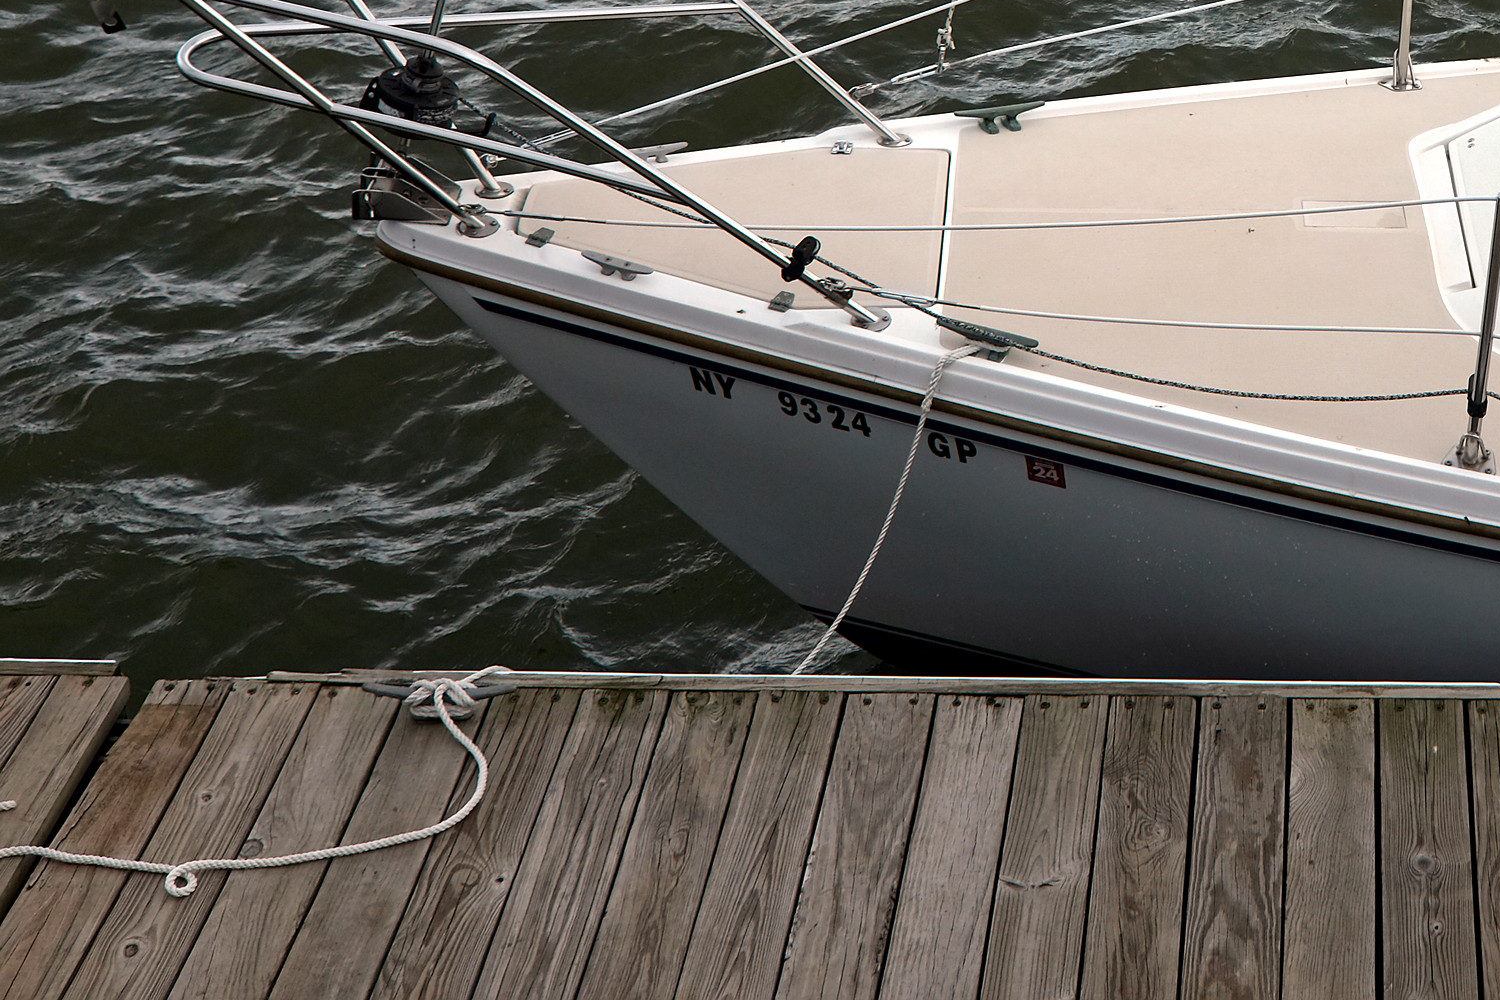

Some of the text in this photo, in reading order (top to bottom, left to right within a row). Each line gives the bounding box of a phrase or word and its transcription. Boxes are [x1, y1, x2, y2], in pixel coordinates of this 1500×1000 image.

[689, 366, 977, 463] NY 9324 GP
[1033, 466, 1059, 481] 24
